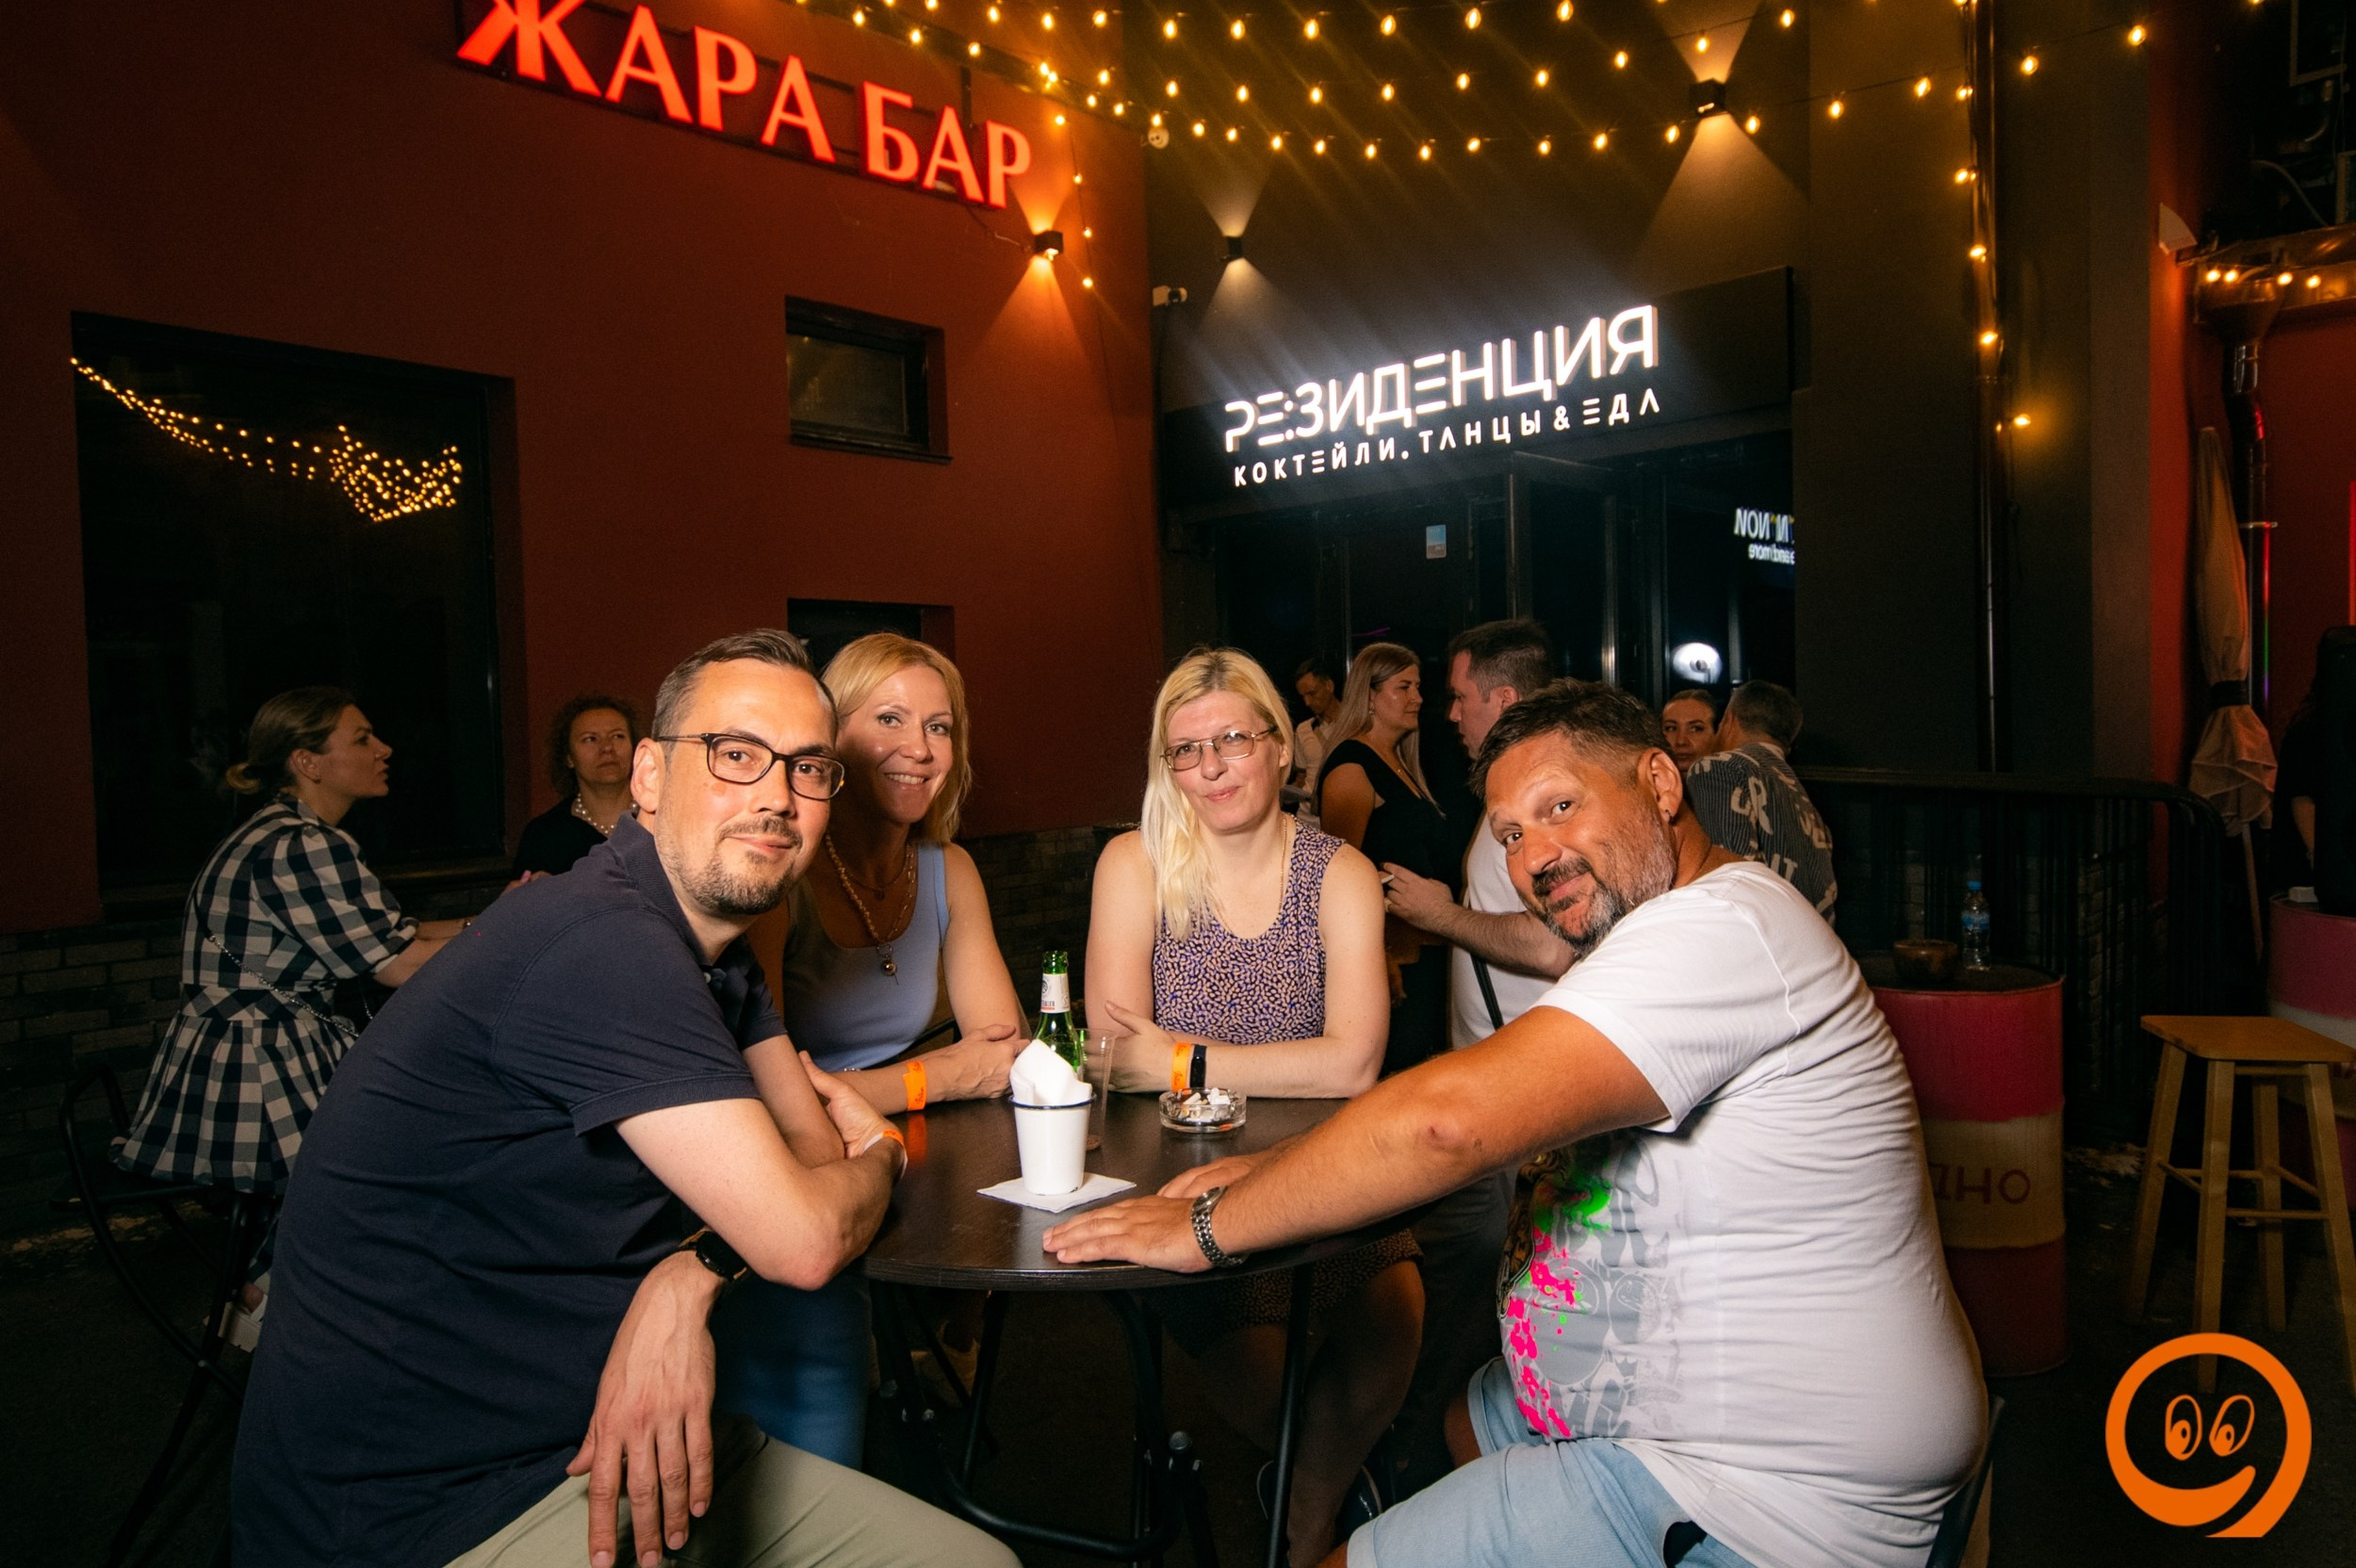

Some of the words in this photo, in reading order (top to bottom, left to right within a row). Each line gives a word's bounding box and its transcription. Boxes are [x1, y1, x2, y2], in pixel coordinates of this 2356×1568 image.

[457, 0, 835, 163] ЖАРА
[862, 81, 1031, 209] БАР
[1234, 437, 1409, 487] КОКТЕЙЛИ.
[1553, 405, 1570, 431] &
